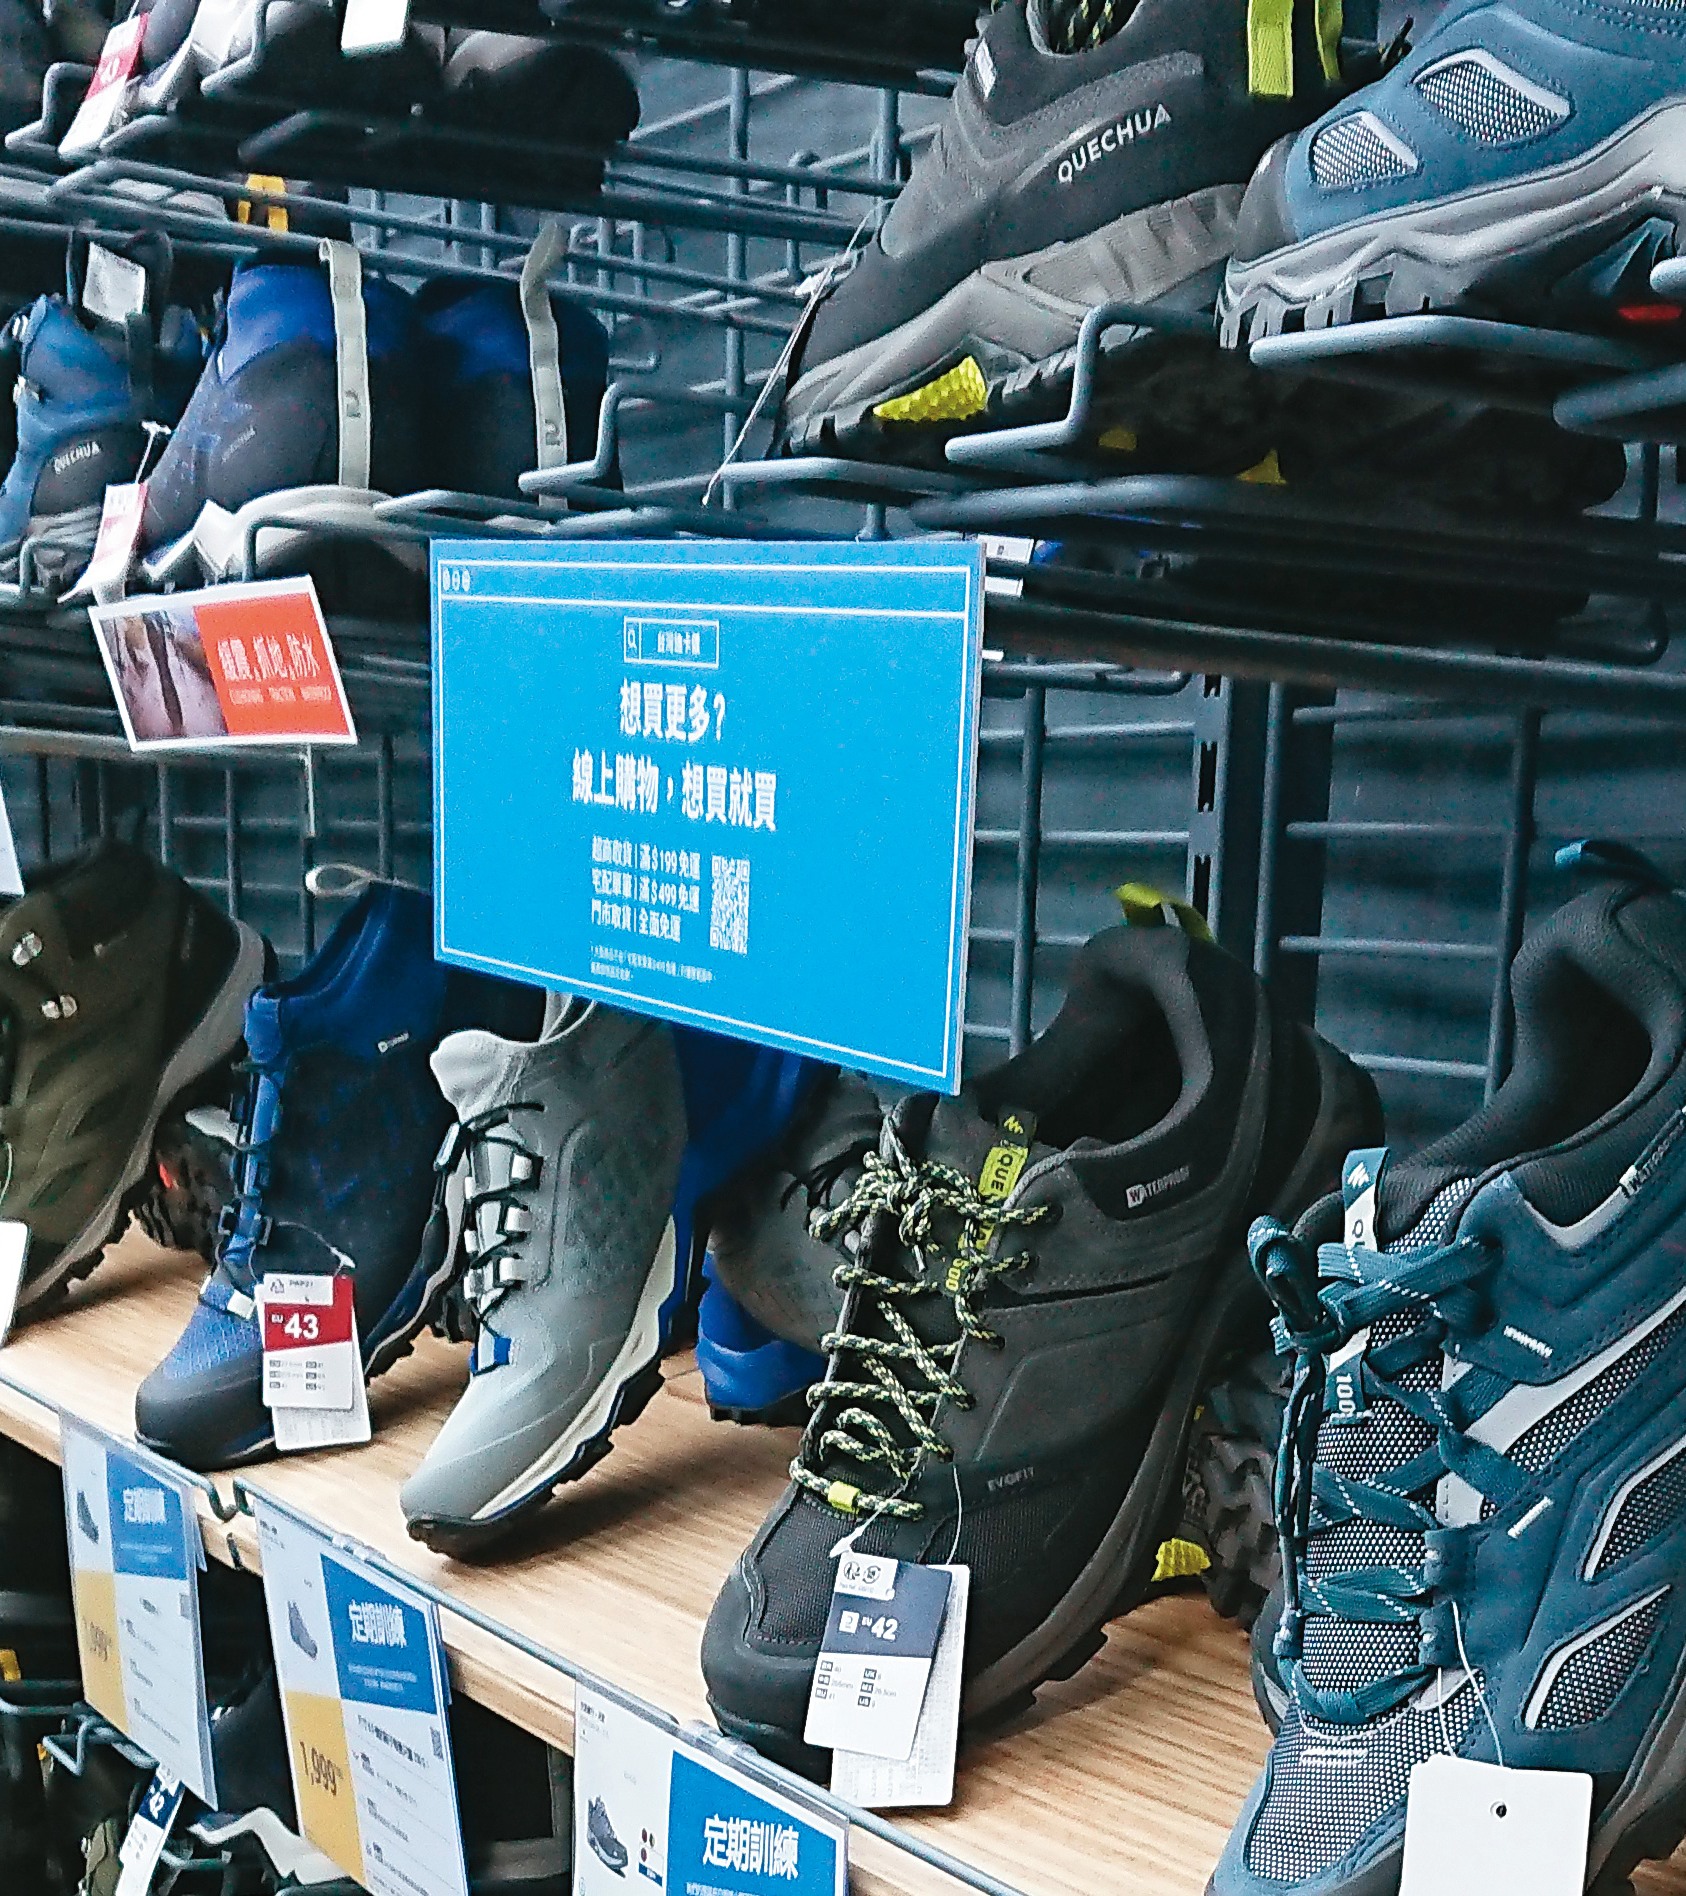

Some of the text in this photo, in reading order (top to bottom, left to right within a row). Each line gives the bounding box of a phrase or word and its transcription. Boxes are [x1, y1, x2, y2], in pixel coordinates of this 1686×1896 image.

[1056, 103, 1173, 185] QUECHUA
[571, 747, 777, 832] 線上購物，想買就買
[284, 1313, 319, 1340] 43
[871, 1616, 899, 1641] 42
[299, 1741, 338, 1797] 1,999
[703, 1814, 800, 1881] 定期訓練
